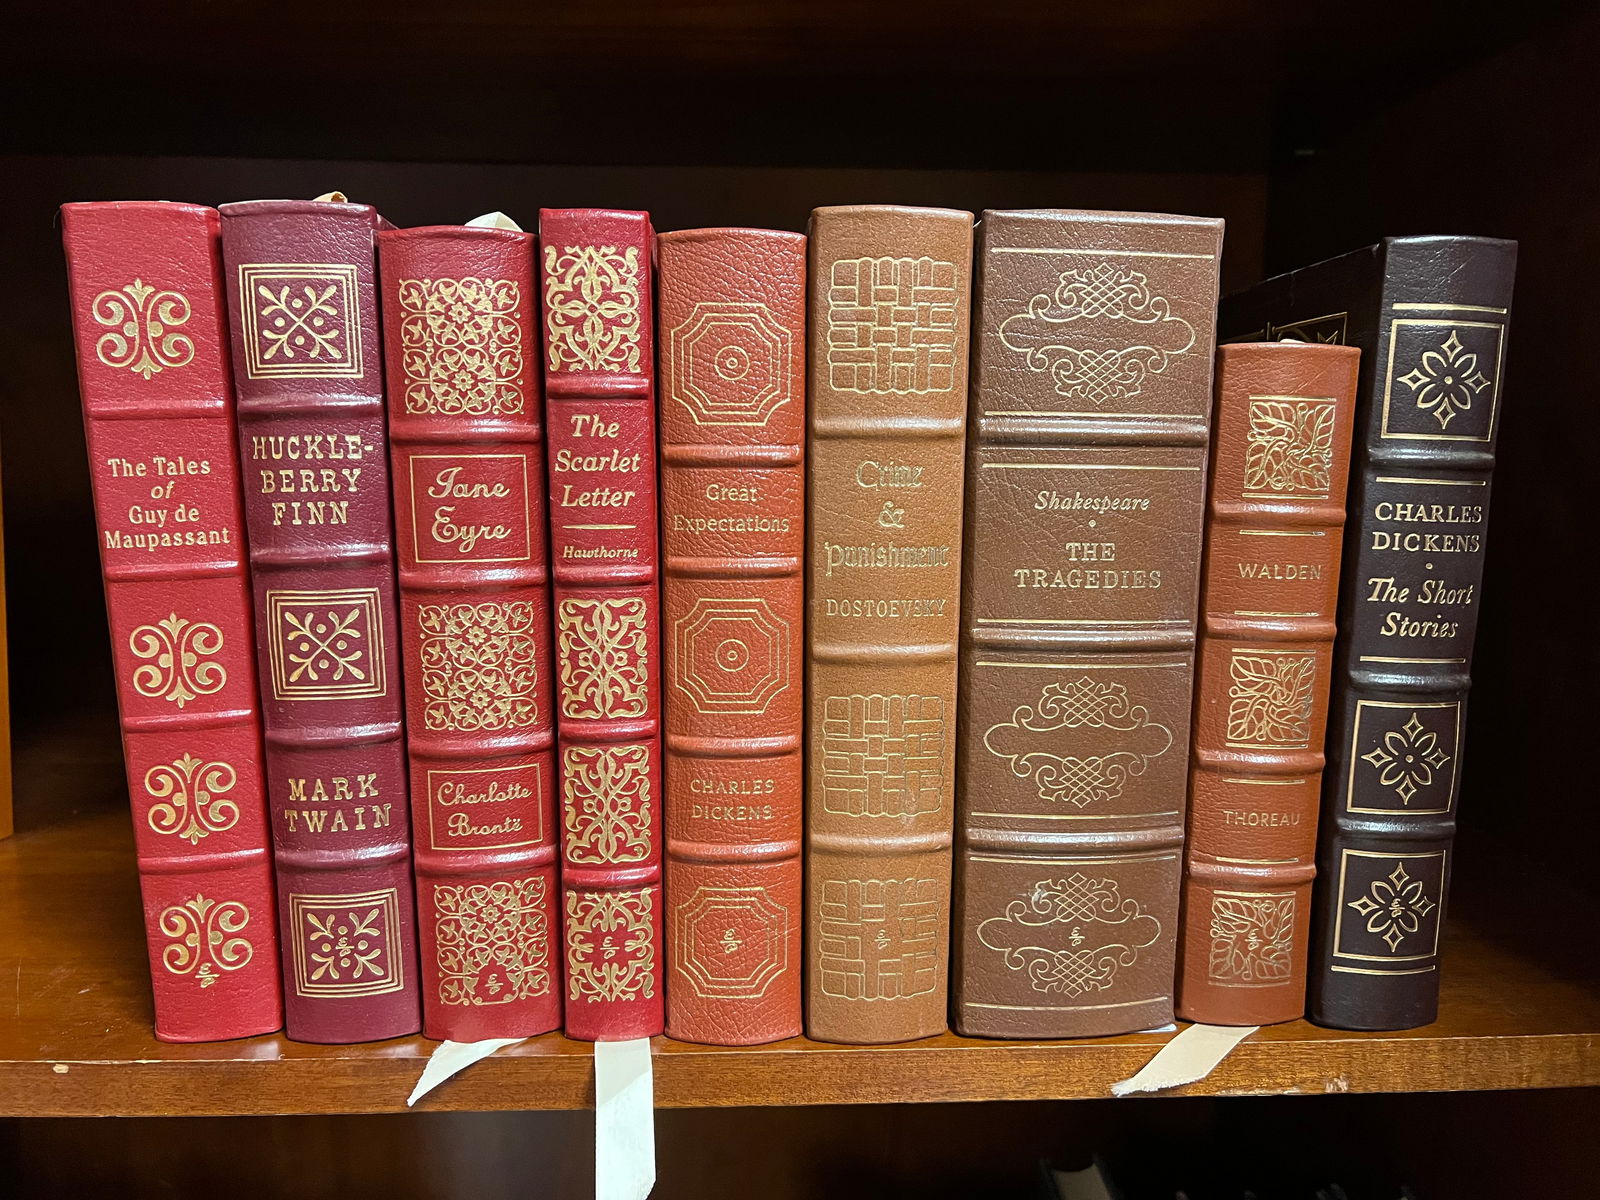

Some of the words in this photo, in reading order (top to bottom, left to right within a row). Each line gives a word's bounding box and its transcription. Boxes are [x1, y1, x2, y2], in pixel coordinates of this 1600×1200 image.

[570, 413, 620, 438] The
[252, 435, 374, 460] HUCKLE-
[108, 459, 147, 477] The
[153, 457, 211, 476] Tales
[555, 449, 640, 473] Scarlet
[261, 468, 362, 494] BERRY
[428, 466, 510, 498] Jane
[855, 460, 924, 491] Crime
[151, 481, 175, 500] of
[560, 485, 635, 507] Letter
[706, 484, 757, 502] Great
[272, 501, 349, 526] FINN
[1034, 491, 1150, 514] Shakespeare
[1375, 502, 1482, 523] CHARLES
[129, 505, 169, 527] Guy
[175, 504, 200, 523] de
[674, 515, 790, 535] Expectations
[878, 501, 905, 528] &
[105, 527, 231, 552] Maupassant
[431, 506, 511, 553] Eyre
[563, 545, 639, 559] Hawthorne
[1065, 543, 1116, 561] THE
[1372, 532, 1480, 552] DICKENS
[824, 541, 949, 576] Punishment
[1014, 569, 1162, 589] TRAGEDIES
[1238, 563, 1322, 580] WALDEN
[1367, 577, 1409, 603] The
[1417, 579, 1473, 605] Short
[826, 599, 947, 618] DOSTOEVSKY
[1380, 612, 1458, 638] Stories
[288, 773, 379, 802] MARK
[437, 782, 533, 806] Charlotte
[690, 779, 775, 795] CHARLES
[285, 803, 391, 832] TWAIN
[691, 805, 774, 821] DICKENS
[1223, 810, 1301, 827] THOREAU
[448, 813, 523, 837] Brontë
